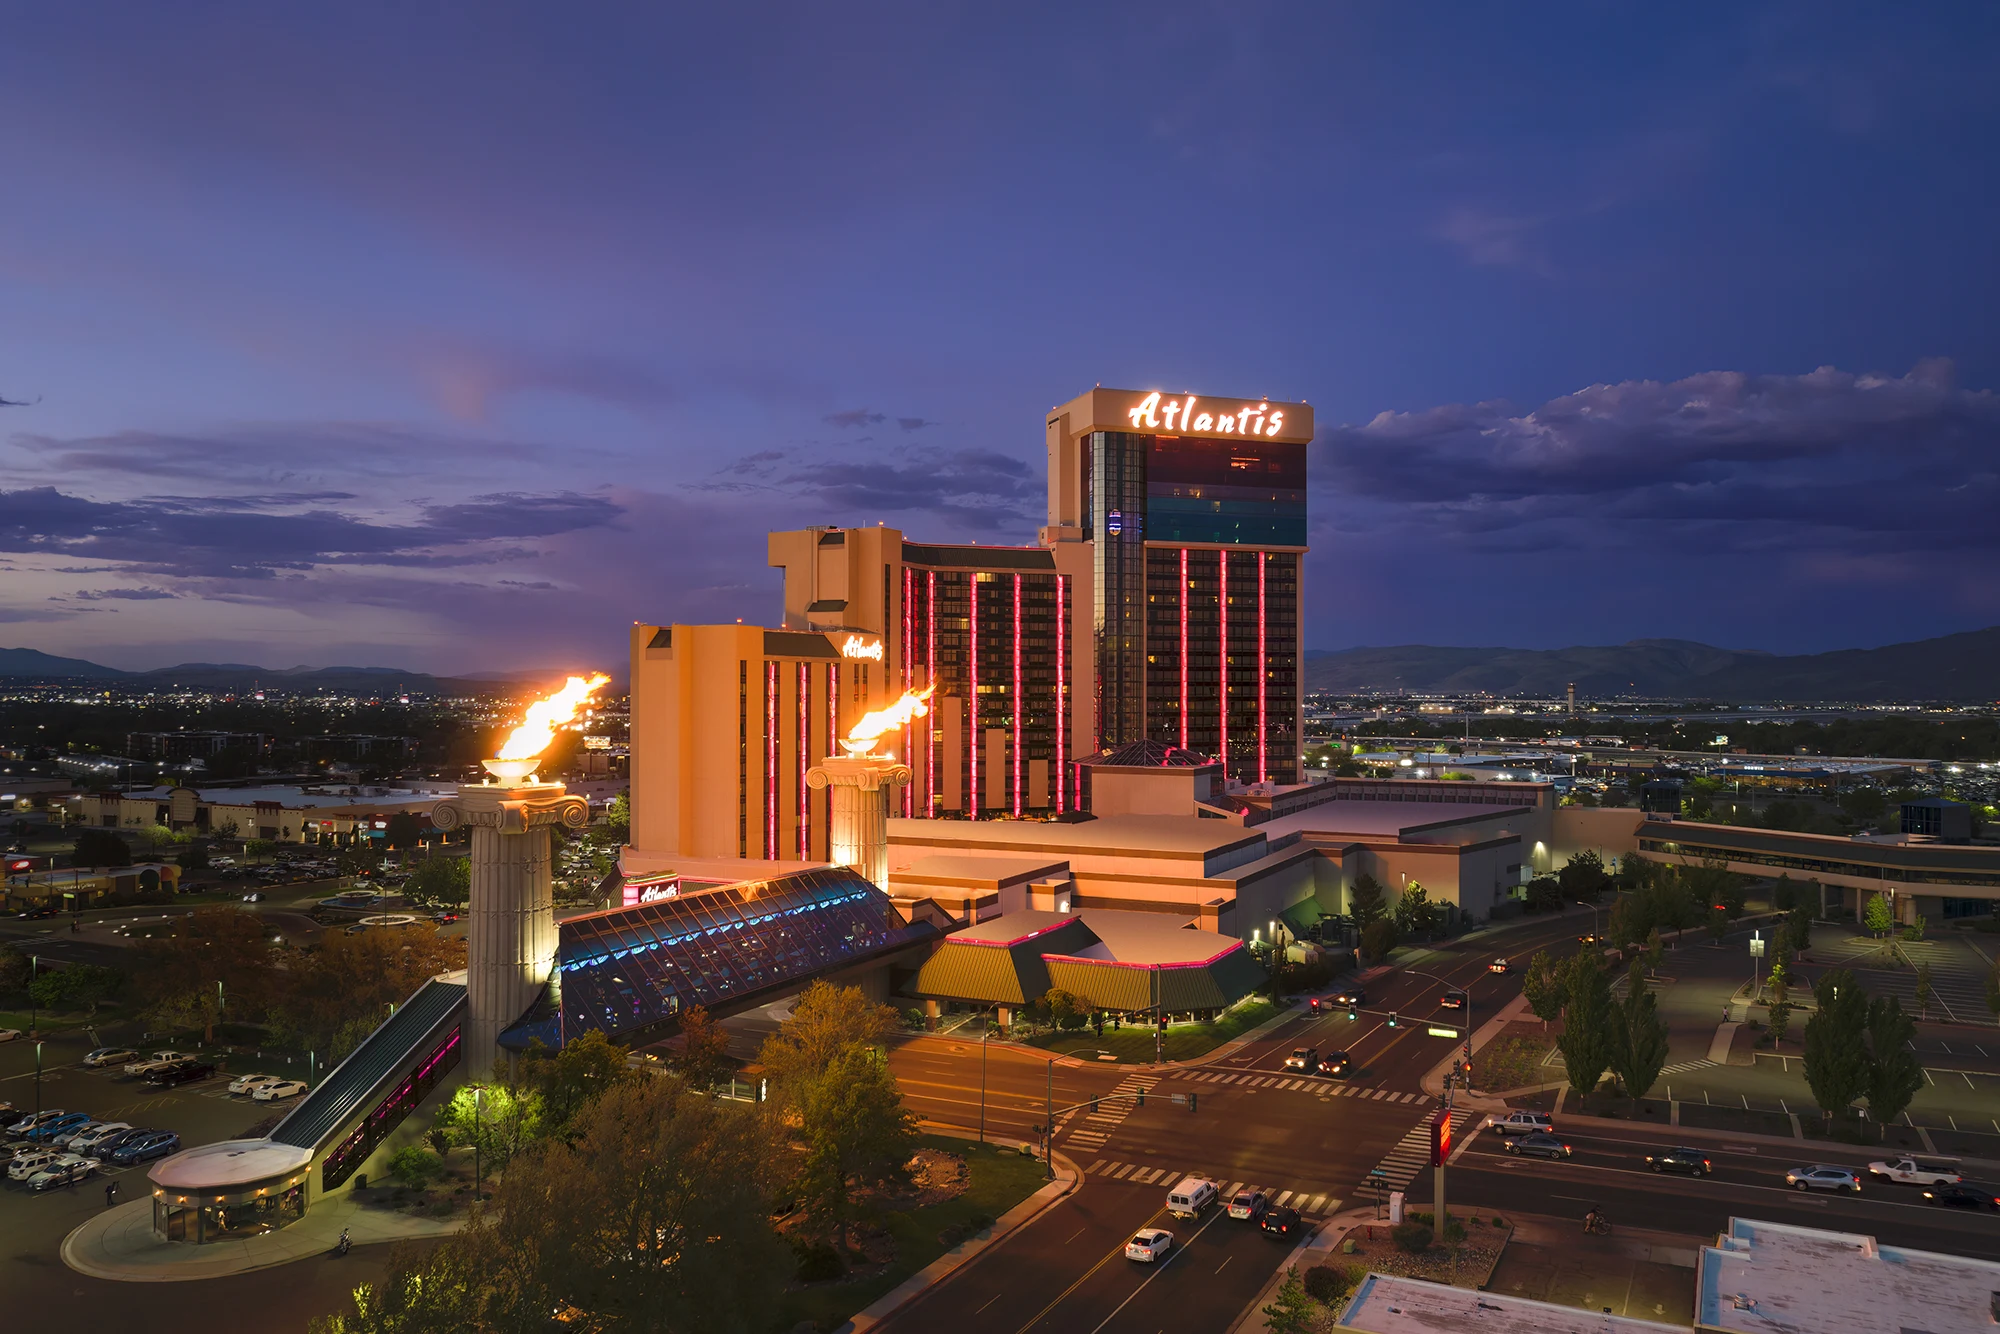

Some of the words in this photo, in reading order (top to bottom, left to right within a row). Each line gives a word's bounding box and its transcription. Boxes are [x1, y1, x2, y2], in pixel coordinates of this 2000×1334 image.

[1128, 391, 1284, 437] Atlantis
[842, 635, 883, 661] Atlantis
[640, 883, 677, 903] Atlantis
